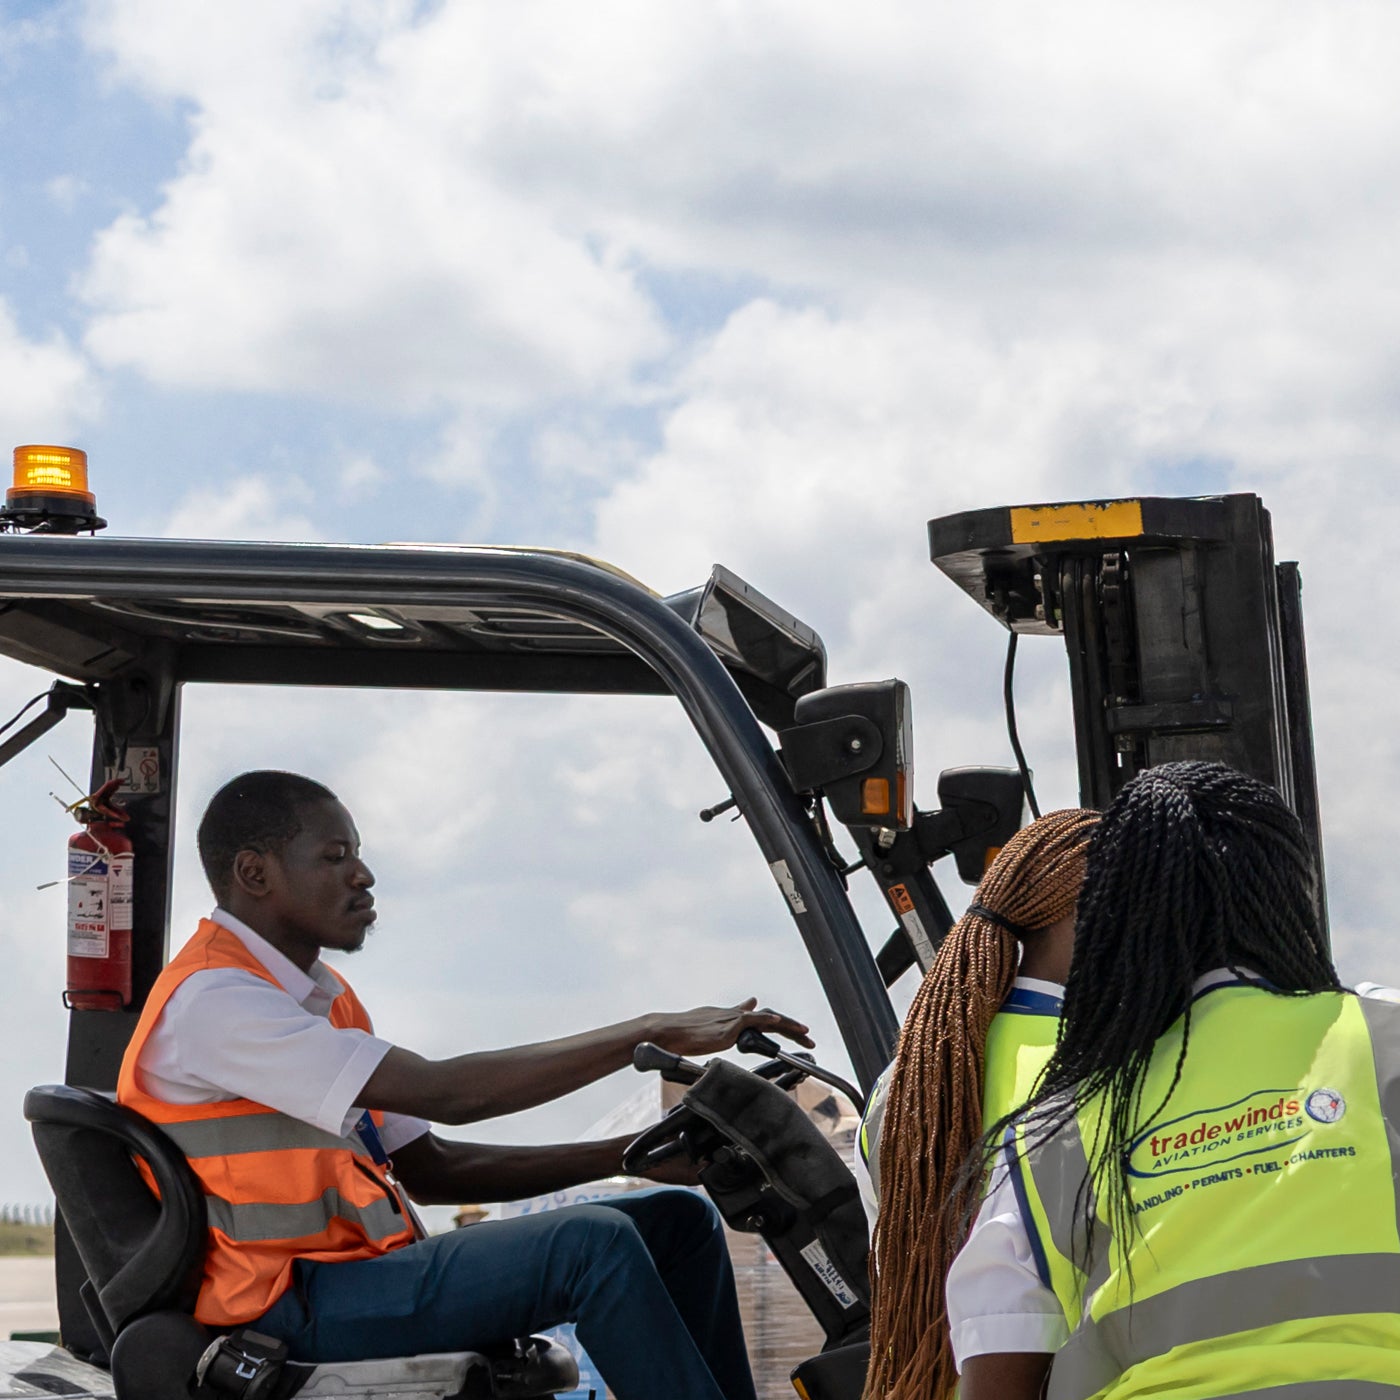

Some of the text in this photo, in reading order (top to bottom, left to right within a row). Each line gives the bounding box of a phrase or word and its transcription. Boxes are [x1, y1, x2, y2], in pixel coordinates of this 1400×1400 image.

[1150, 1098, 1300, 1157] tradewinds
[1152, 1116, 1303, 1169] AVIATION SERVICES
[1130, 1146, 1356, 1216] HANDLING PERMITS FUEL CHARTERS
